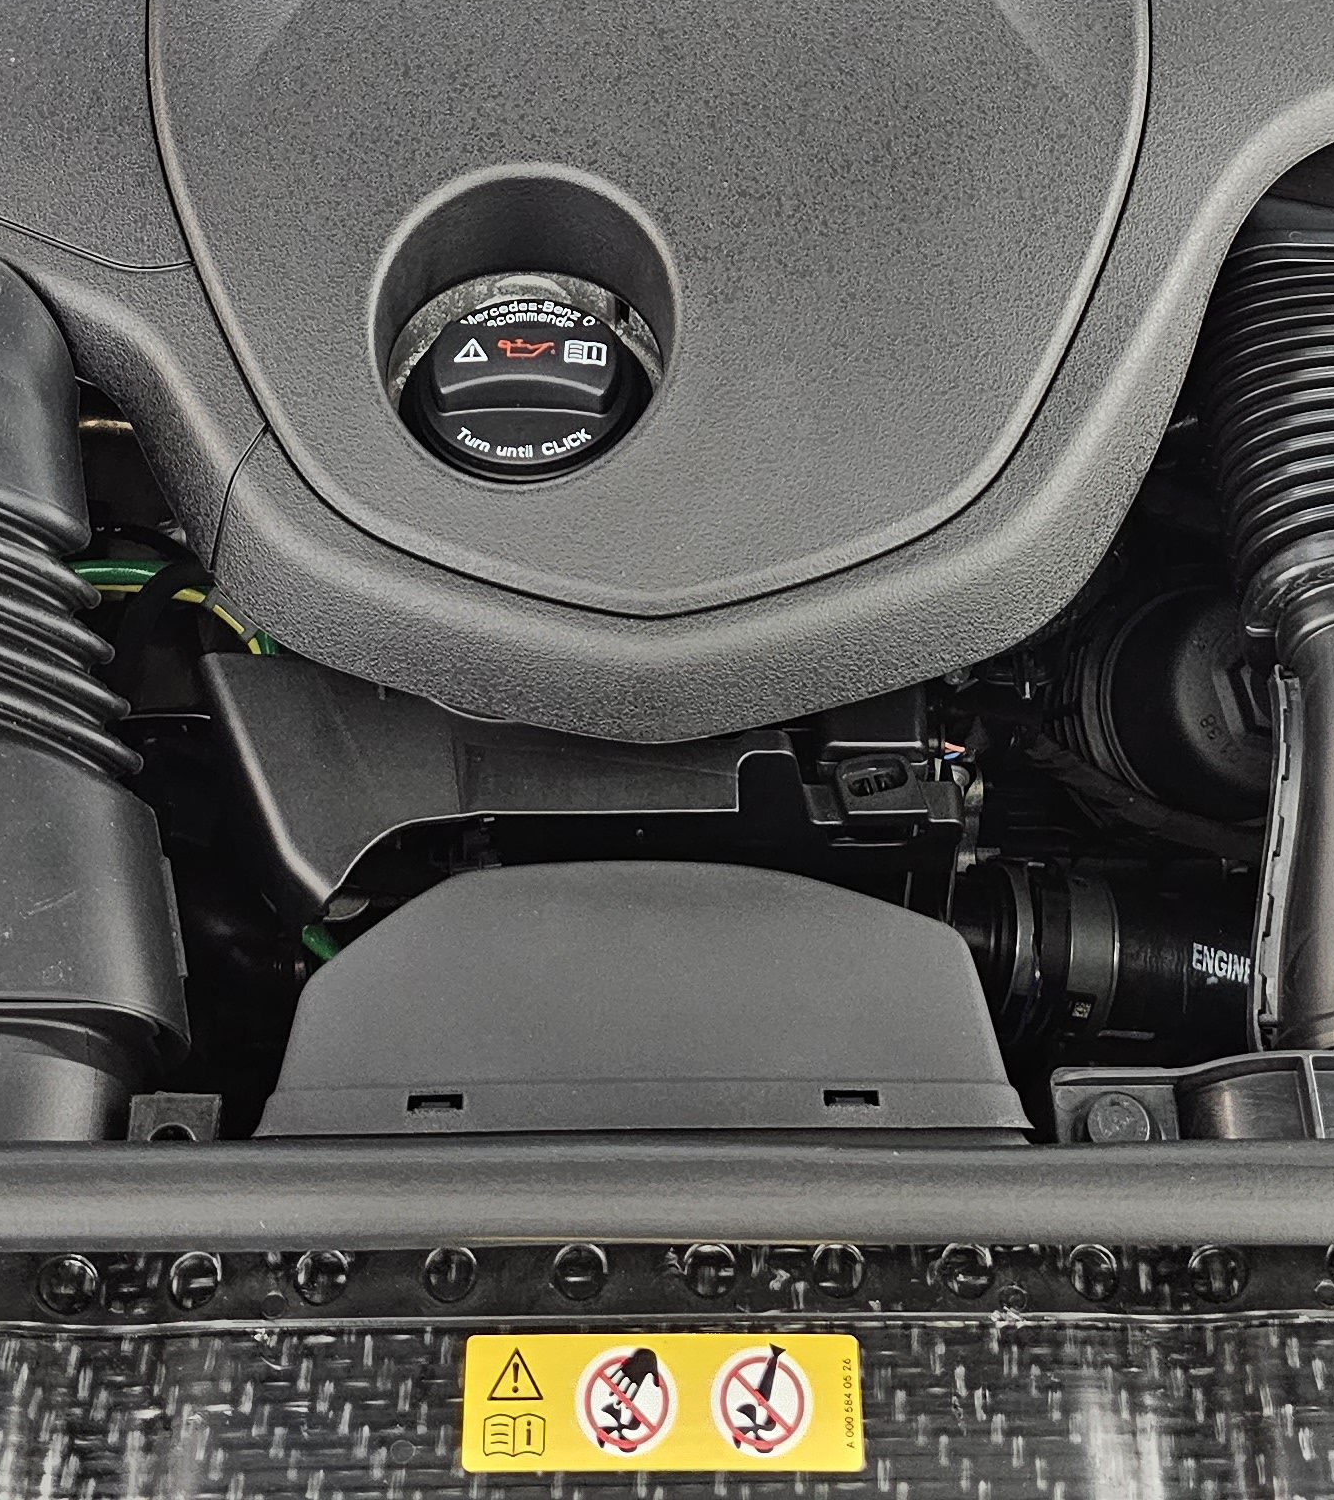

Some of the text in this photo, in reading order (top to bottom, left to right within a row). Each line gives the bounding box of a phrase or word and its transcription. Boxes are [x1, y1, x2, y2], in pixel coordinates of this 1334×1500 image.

[460, 300, 581, 326] Mercedes-Benz
[456, 427, 592, 458] Turn until CLICK
[842, 1358, 852, 1371] 26
[844, 1393, 854, 1413] 584
[845, 1416, 855, 1438] 000
